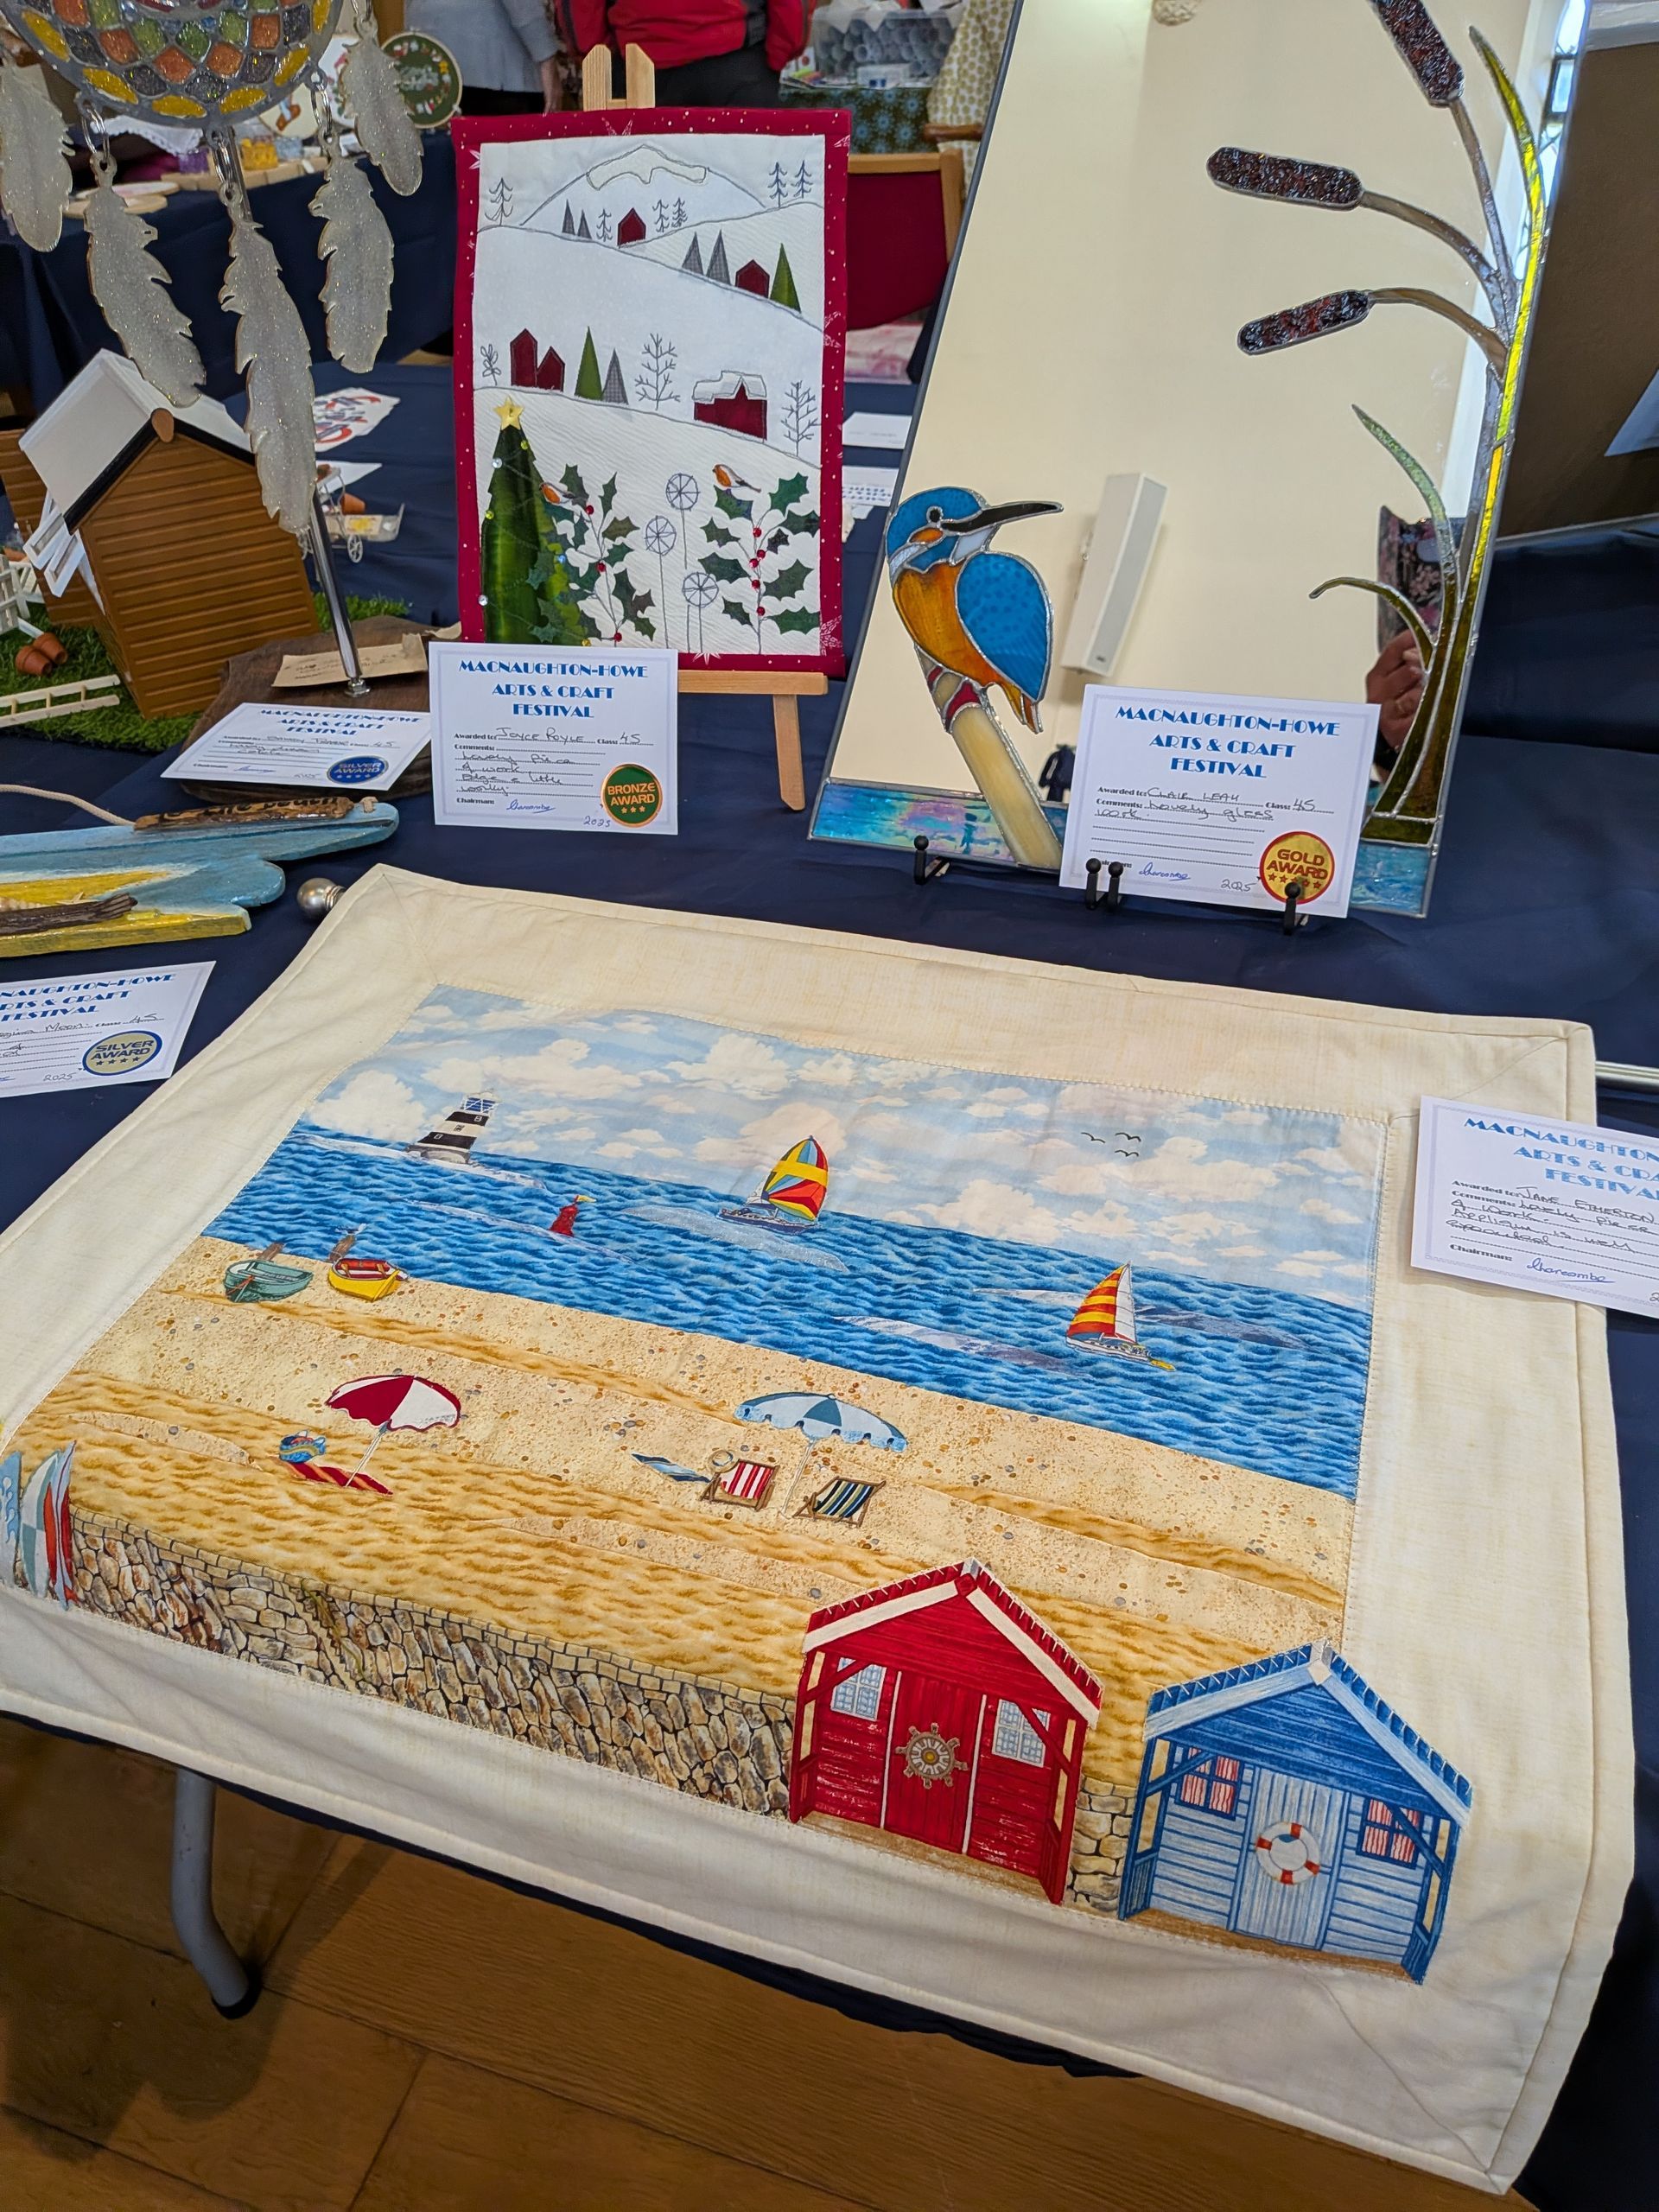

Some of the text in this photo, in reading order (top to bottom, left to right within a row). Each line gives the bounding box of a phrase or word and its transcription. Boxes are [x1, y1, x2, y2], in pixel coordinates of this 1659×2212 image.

[459, 660, 649, 678] MACNAUGHTON-HOWE
[492, 683, 615, 699] ARTS & CRAFT
[512, 703, 594, 718] FESTIVAL
[1115, 706, 1340, 737] MACNAUGHTON-HOWE
[1149, 734, 1297, 759] ARTS & CRAFT
[1171, 757, 1268, 779] FESTIVAL
[607, 782, 656, 795] BRONZE
[610, 793, 656, 806] AWARD
[1096, 798, 1143, 809] Comments:
[1097, 786, 1135, 797] Awarded
[1265, 801, 1291, 810] Class:
[1277, 849, 1325, 867] GOLD
[1266, 860, 1329, 880] AWARD
[41, 999, 58, 1007] &
[62, 990, 132, 1005] CRAFT
[1, 1005, 99, 1022] FESTIVAL
[91, 1048, 151, 1060] AWARD
[95, 1039, 155, 1052] SILVER
[43, 1071, 77, 1082] 2025
[1513, 1147, 1581, 1166] ARTS
[1587, 1160, 1607, 1173] &
[1452, 1180, 1503, 1194] Awarded
[1545, 1168, 1659, 1200] FESTIVA
[1452, 1190, 1516, 1207] Comments:
[1450, 1244, 1513, 1262] Chairman:
